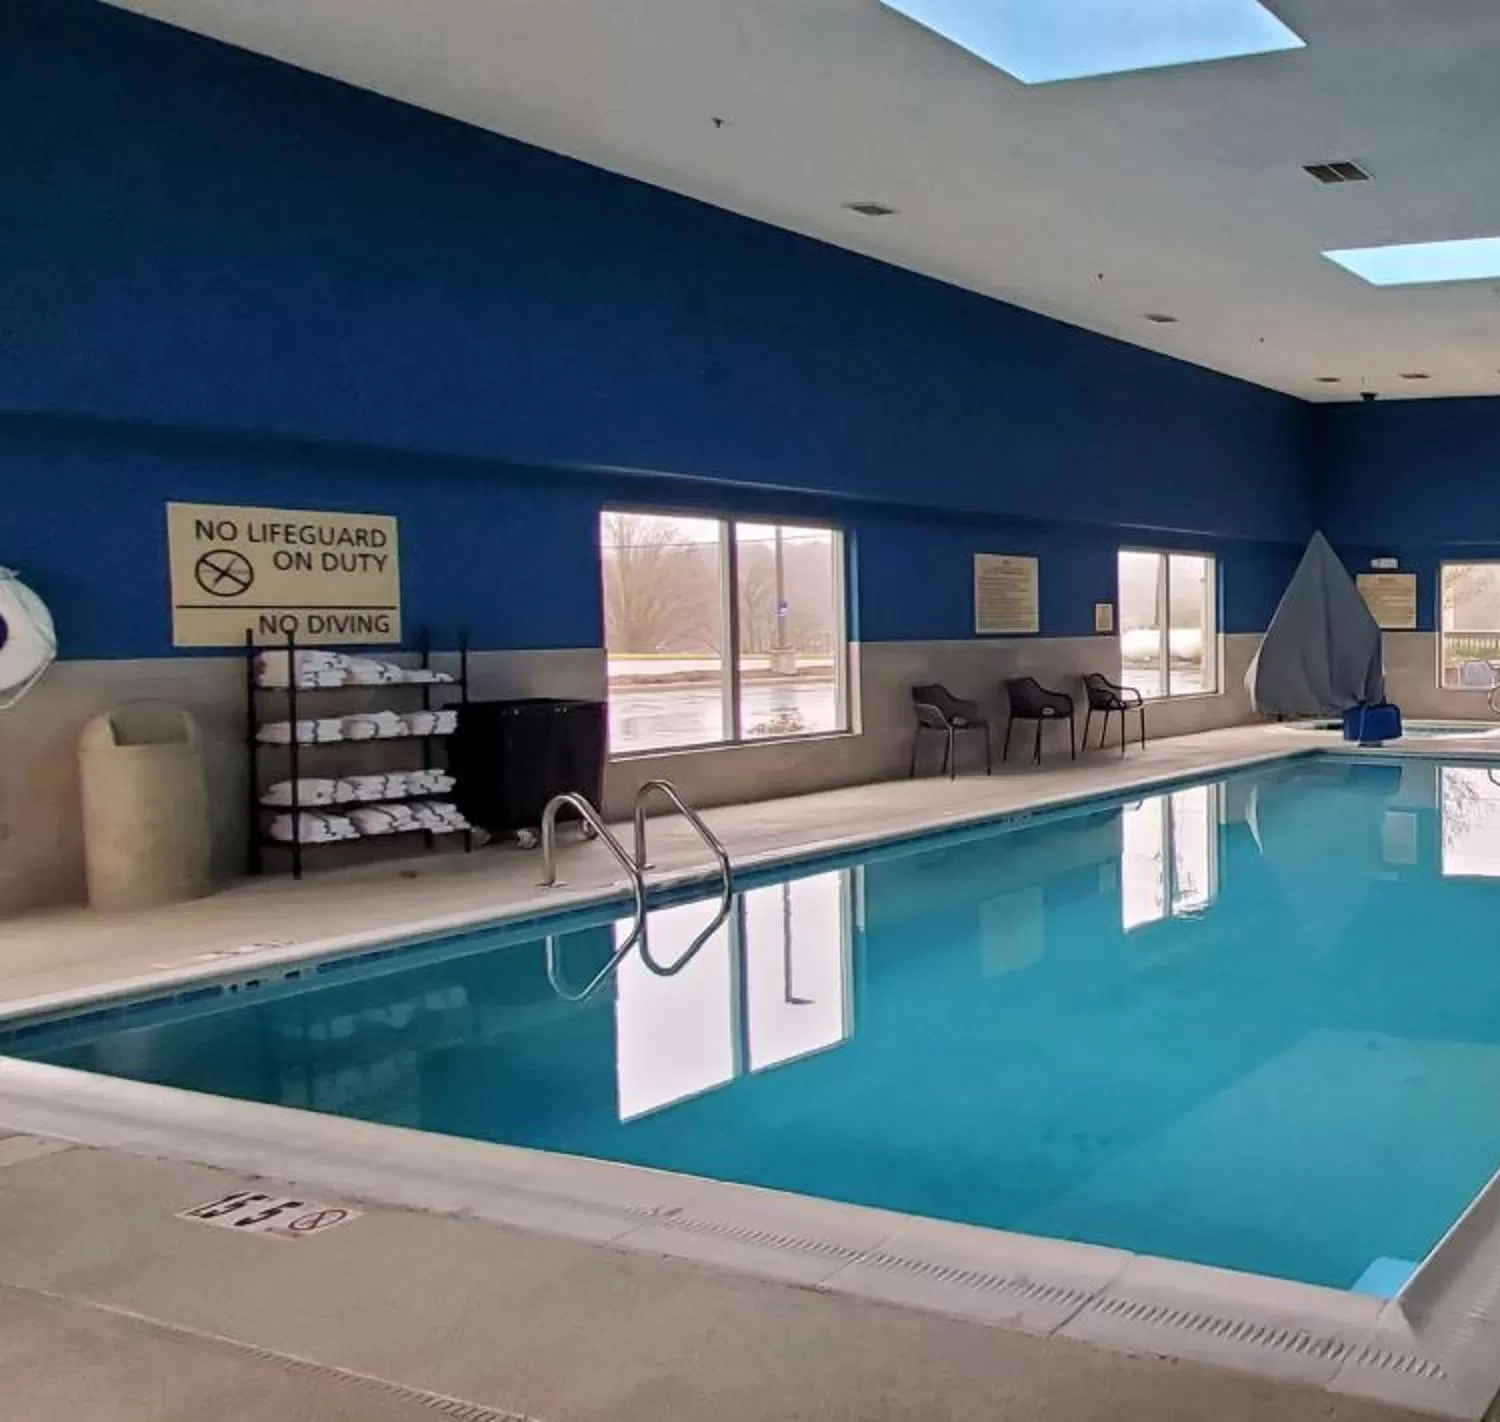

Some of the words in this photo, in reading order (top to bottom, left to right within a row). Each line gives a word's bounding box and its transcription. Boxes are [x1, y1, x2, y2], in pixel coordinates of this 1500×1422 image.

[194, 519, 237, 542] NO
[247, 522, 387, 548] LIFEGUARD
[273, 550, 312, 571] ON
[321, 552, 389, 572] DUTY
[259, 615, 298, 635] NO
[307, 615, 390, 634] DIVING
